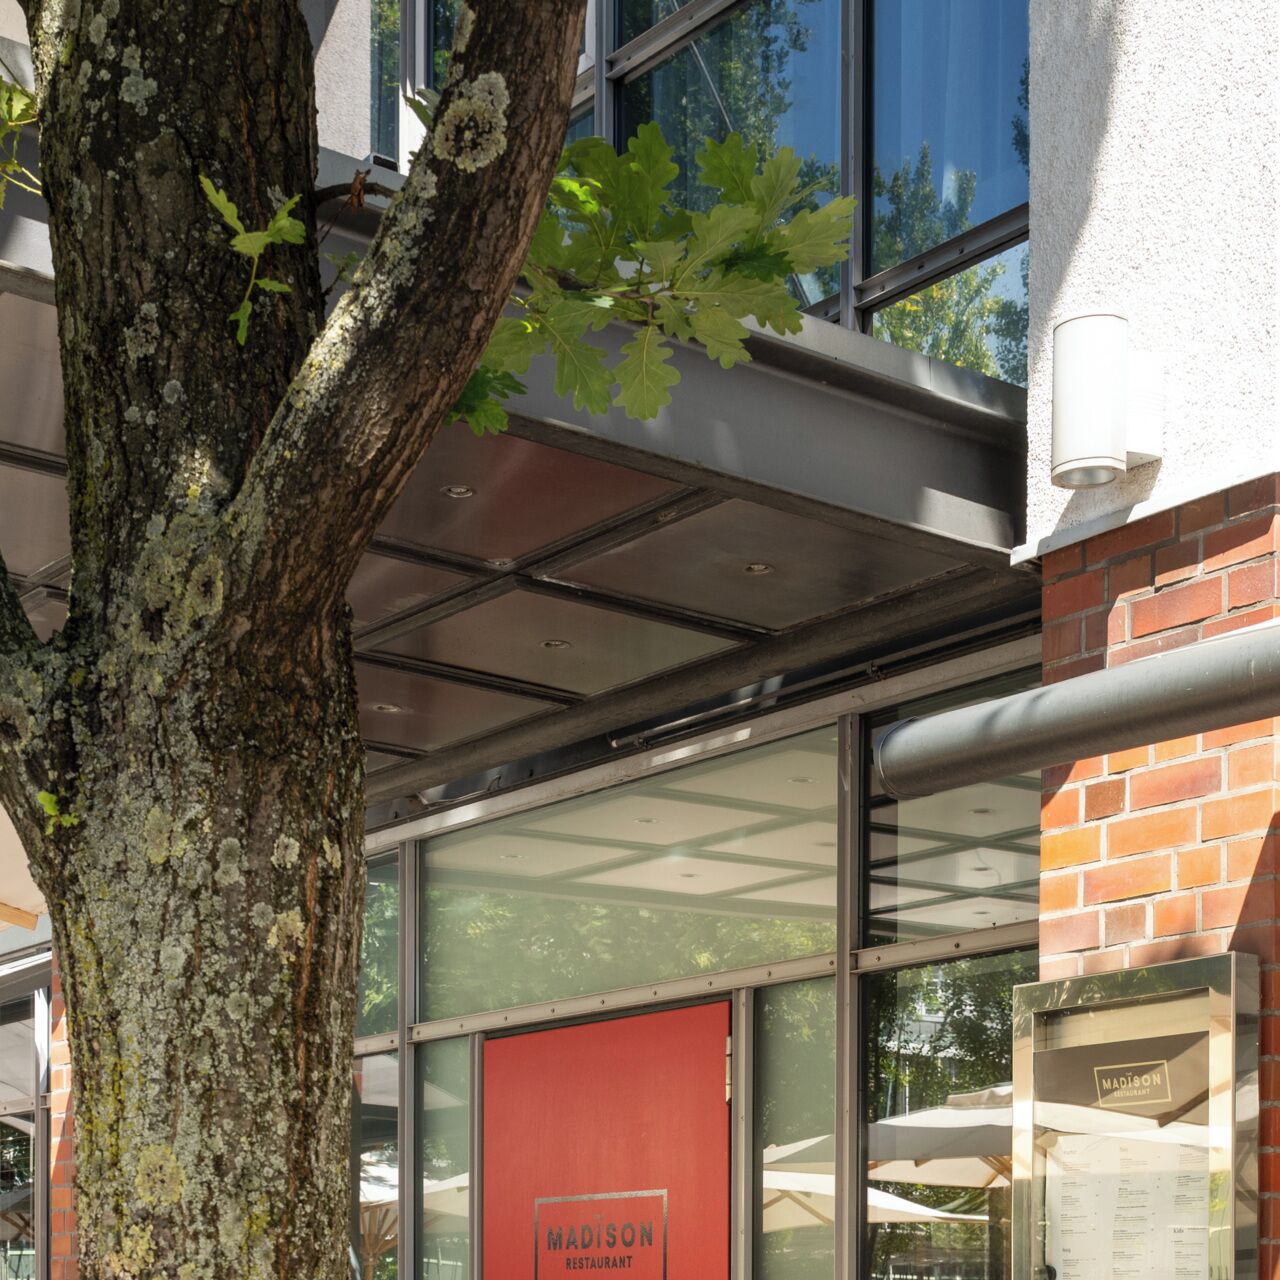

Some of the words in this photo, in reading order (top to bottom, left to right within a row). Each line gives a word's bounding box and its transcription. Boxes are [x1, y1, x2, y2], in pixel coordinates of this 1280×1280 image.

[1102, 1073, 1161, 1090] MADISON
[547, 1221, 653, 1251] MADISON
[565, 1255, 633, 1270] RESTAURANT
